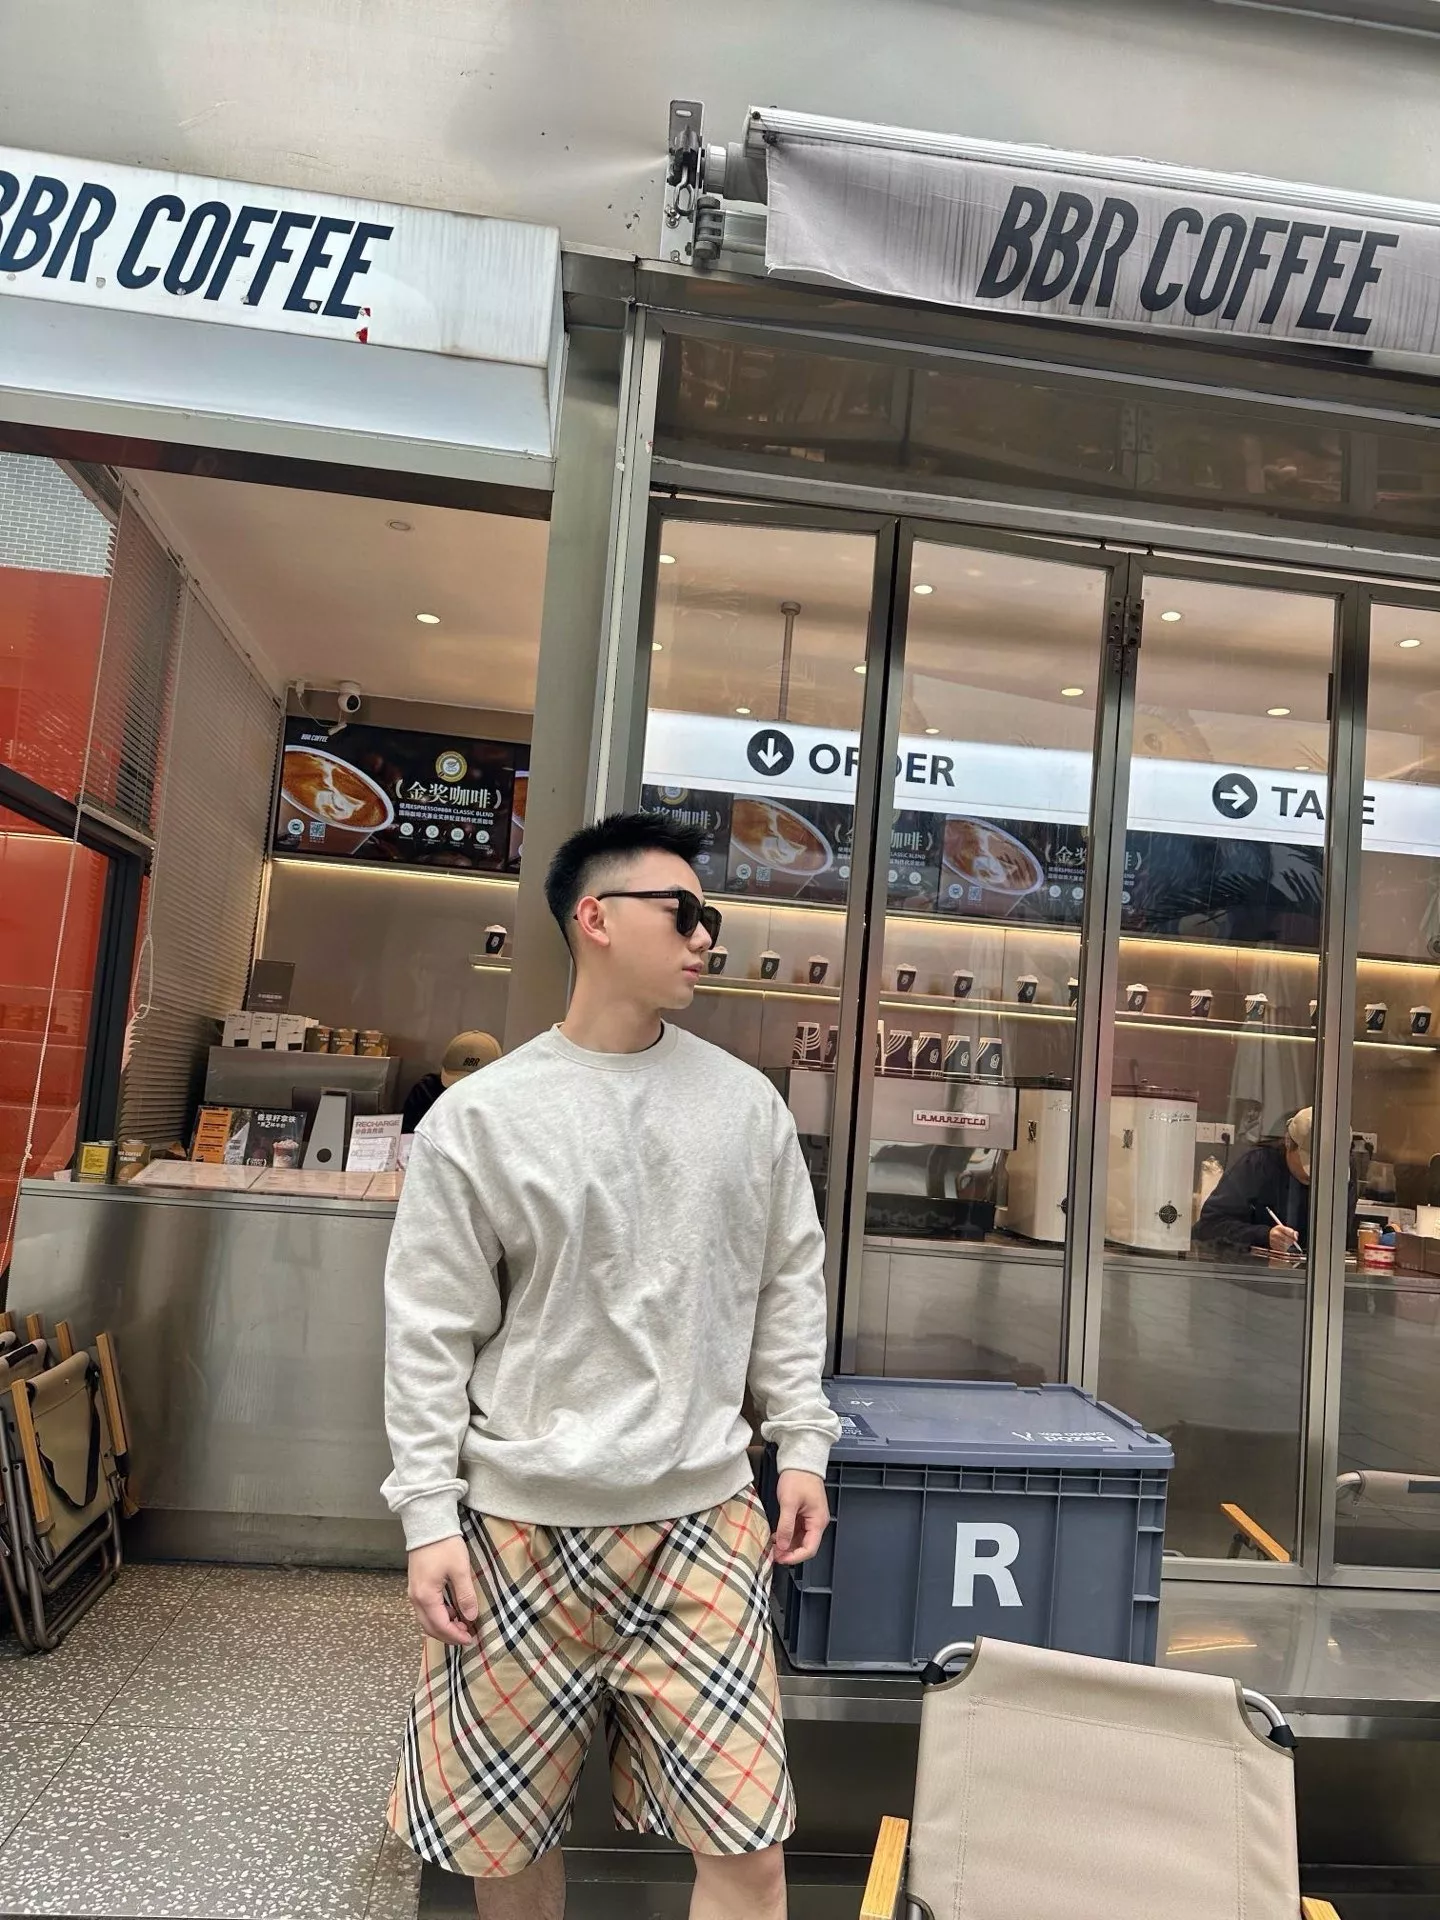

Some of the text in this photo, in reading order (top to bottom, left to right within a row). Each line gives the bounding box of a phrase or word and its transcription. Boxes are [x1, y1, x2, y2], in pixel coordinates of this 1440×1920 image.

[0, 169, 394, 320] BR COFFEE
[975, 185, 1400, 335] BBR COFFEE
[1271, 786, 1376, 826] TAE
[355, 1119, 401, 1128] RECHARGE
[951, 1522, 1024, 1607] R
